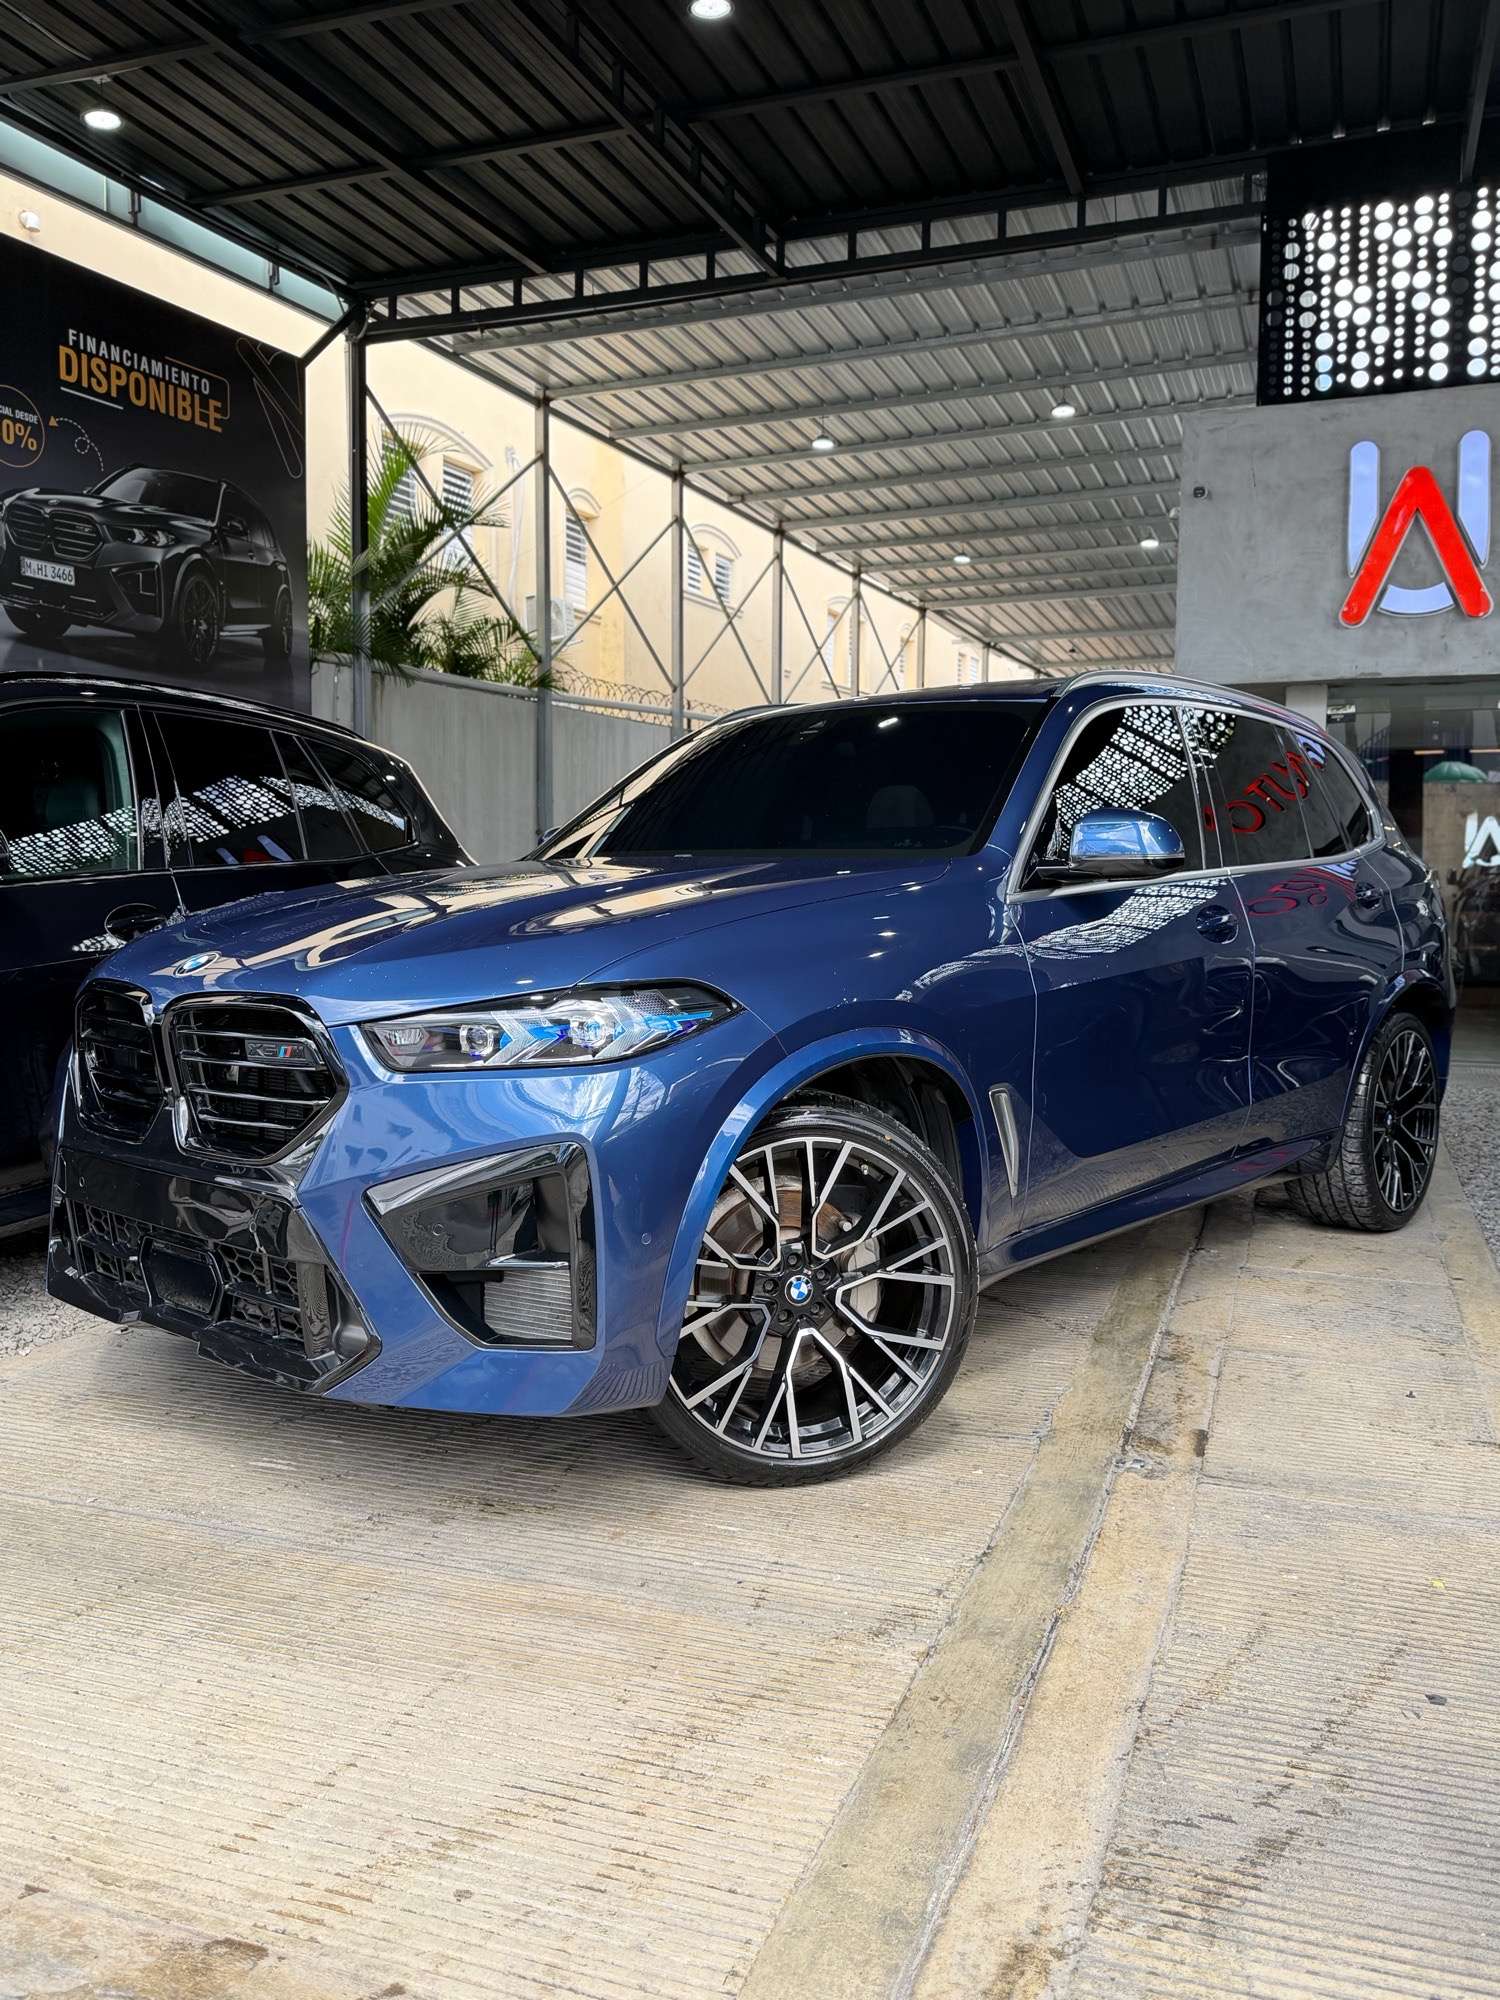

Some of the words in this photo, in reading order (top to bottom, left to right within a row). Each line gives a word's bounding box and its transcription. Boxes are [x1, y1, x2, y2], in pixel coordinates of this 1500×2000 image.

[68, 328, 210, 395] FINANCIAMIENTO
[58, 344, 223, 433] DISPONIBLE
[15, 409, 39, 425] DESDE
[2, 418, 37, 451] 0%
[51, 566, 74, 583] 3466
